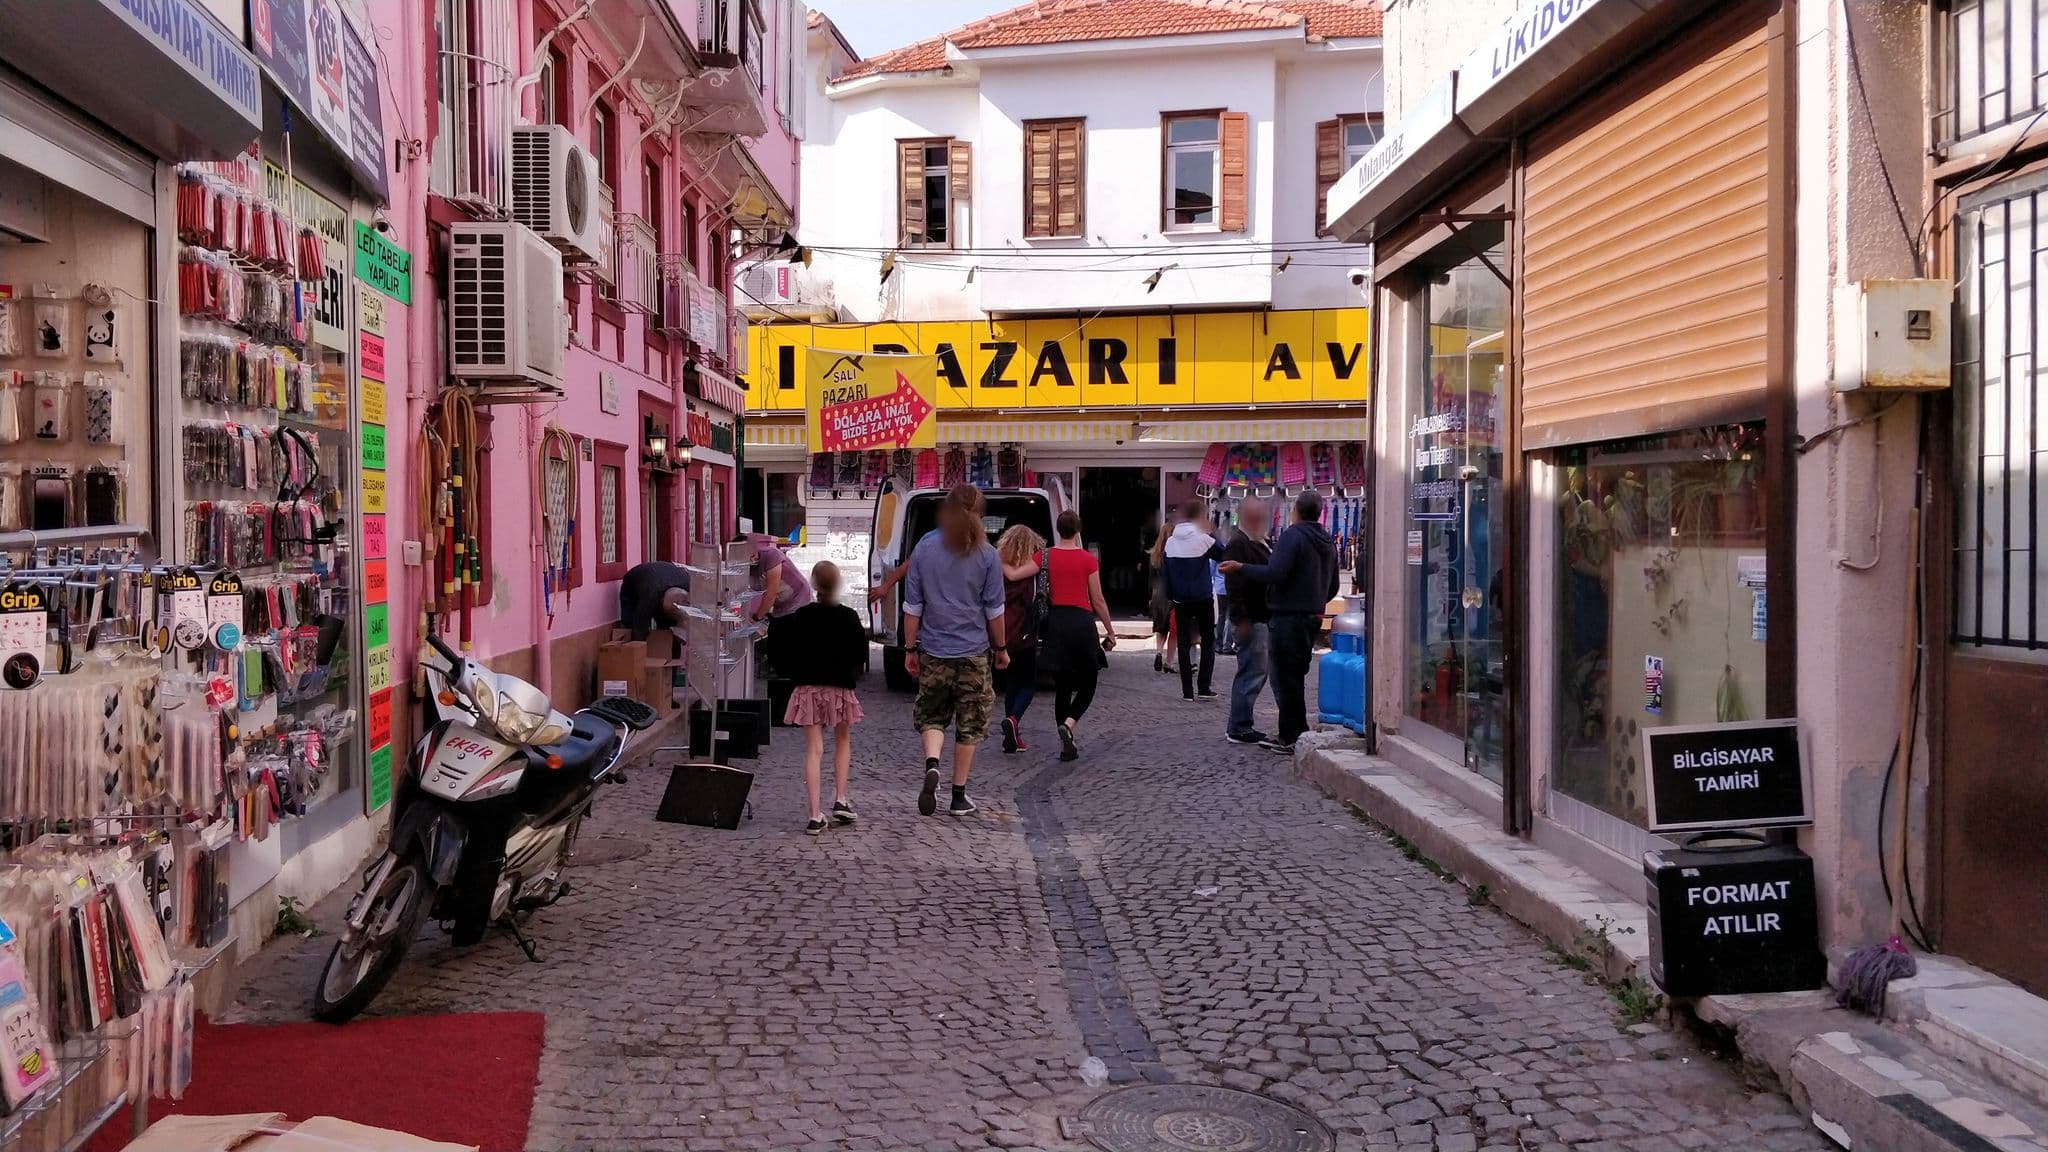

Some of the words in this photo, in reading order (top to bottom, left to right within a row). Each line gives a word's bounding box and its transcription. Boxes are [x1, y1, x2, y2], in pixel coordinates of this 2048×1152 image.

[1492, 0, 1591, 79] LİKİDG
[207, 28, 257, 115] TAMİRİ
[357, 230, 375, 256] LED
[378, 242, 411, 278] TABELA
[368, 261, 400, 295] YAPILIR
[873, 338, 1177, 388] AZARI
[833, 368, 857, 383] SALI
[823, 383, 869, 408] PAZARI
[834, 409, 882, 431] DOLARA
[885, 402, 911, 419] İNAT
[871, 419, 891, 433] ZAM
[895, 414, 914, 427] YOK
[213, 580, 239, 593] Grip
[1, 592, 40, 608] Grip
[371, 618, 384, 635] SAAT
[1673, 747, 1775, 770] BİLGİSAYAR
[1695, 769, 1760, 792] TAMİRİ
[1688, 881, 1791, 906] FORMAT
[1703, 912, 1781, 936] ATILIR
